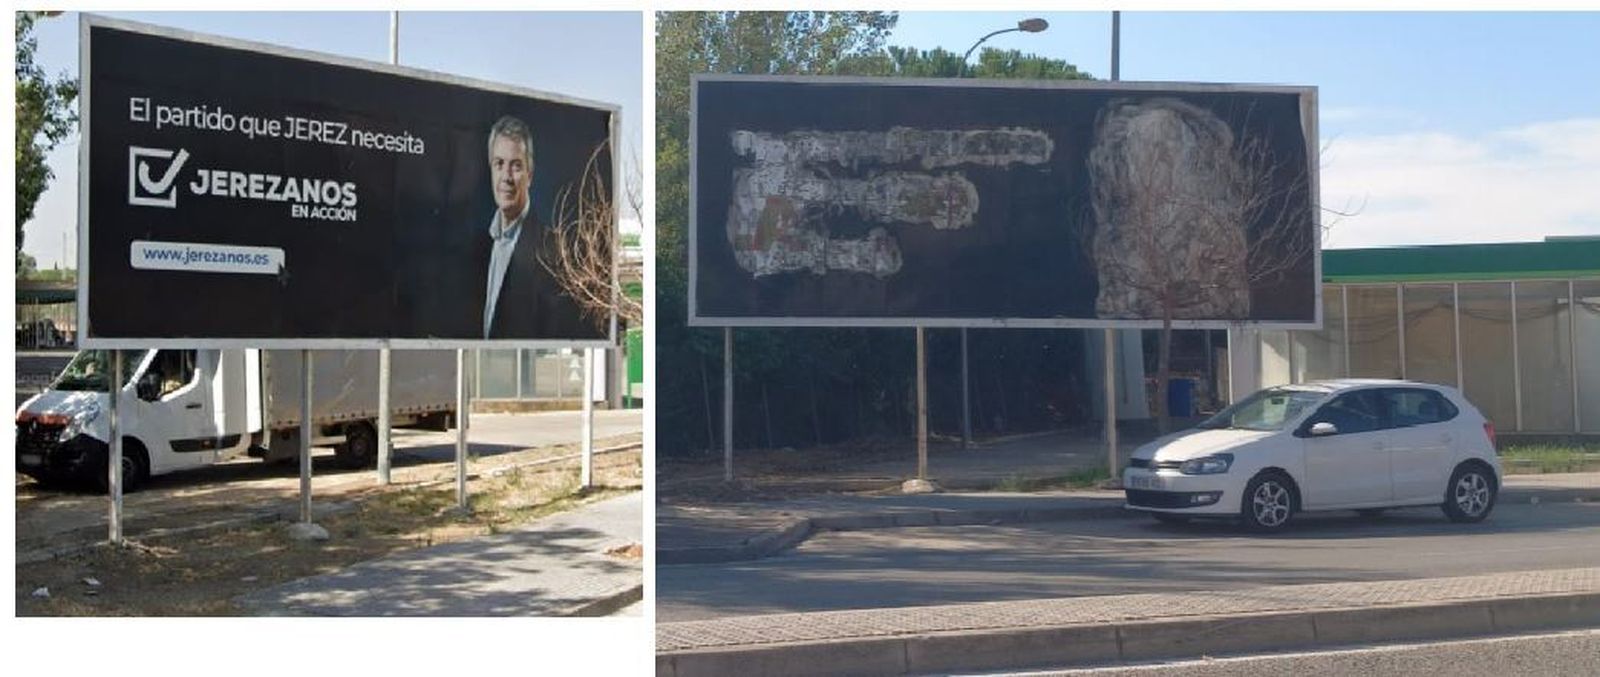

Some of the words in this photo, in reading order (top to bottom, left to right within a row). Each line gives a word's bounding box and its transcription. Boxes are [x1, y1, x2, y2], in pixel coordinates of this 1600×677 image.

[130, 97, 150, 122] El
[156, 103, 236, 131] partido
[239, 115, 281, 139] que
[284, 117, 348, 145] JEREZ
[351, 129, 425, 155] necesita
[189, 169, 358, 208] JEREZANOS
[291, 204, 309, 219] EN
[310, 204, 357, 222] ACCIÓN
[143, 247, 270, 267] www.jerezanos.es
